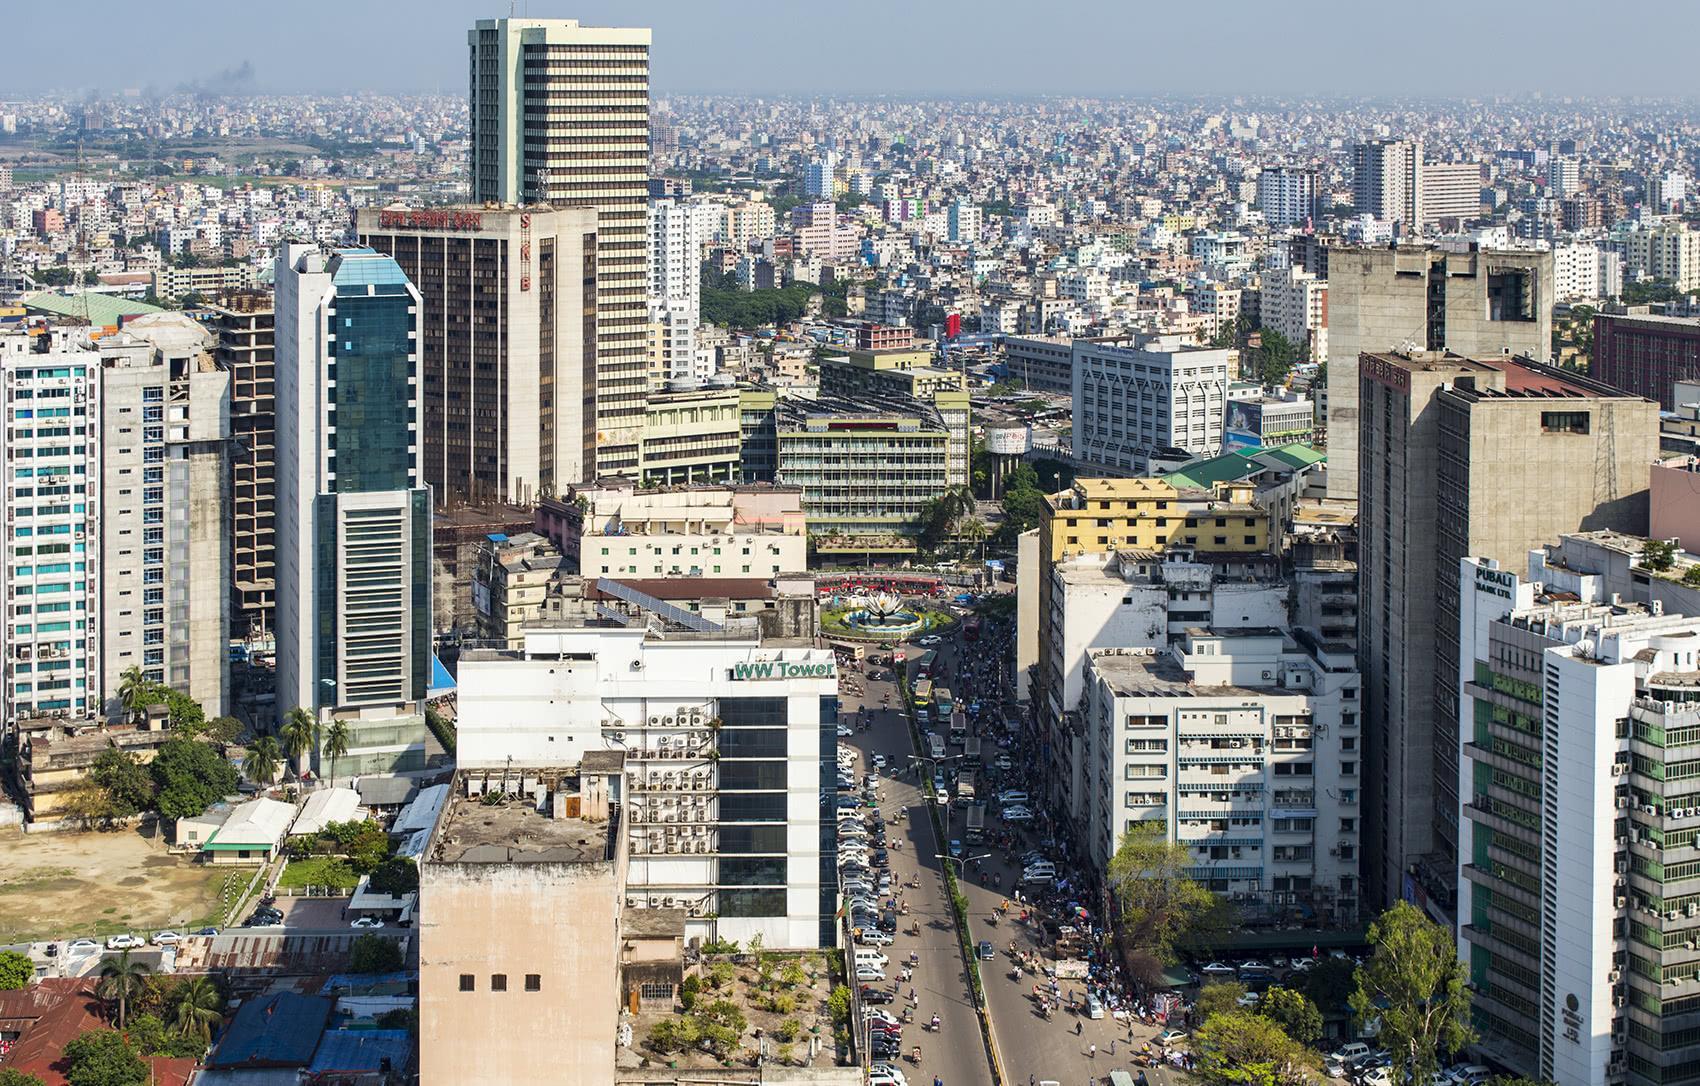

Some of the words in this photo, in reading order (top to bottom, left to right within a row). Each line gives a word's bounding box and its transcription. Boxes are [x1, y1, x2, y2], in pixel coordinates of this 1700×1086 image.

[1476, 567, 1512, 588] PUBALI
[1476, 582, 1496, 596] BANK
[735, 661, 774, 679] WW
[777, 662, 835, 677] Tower
